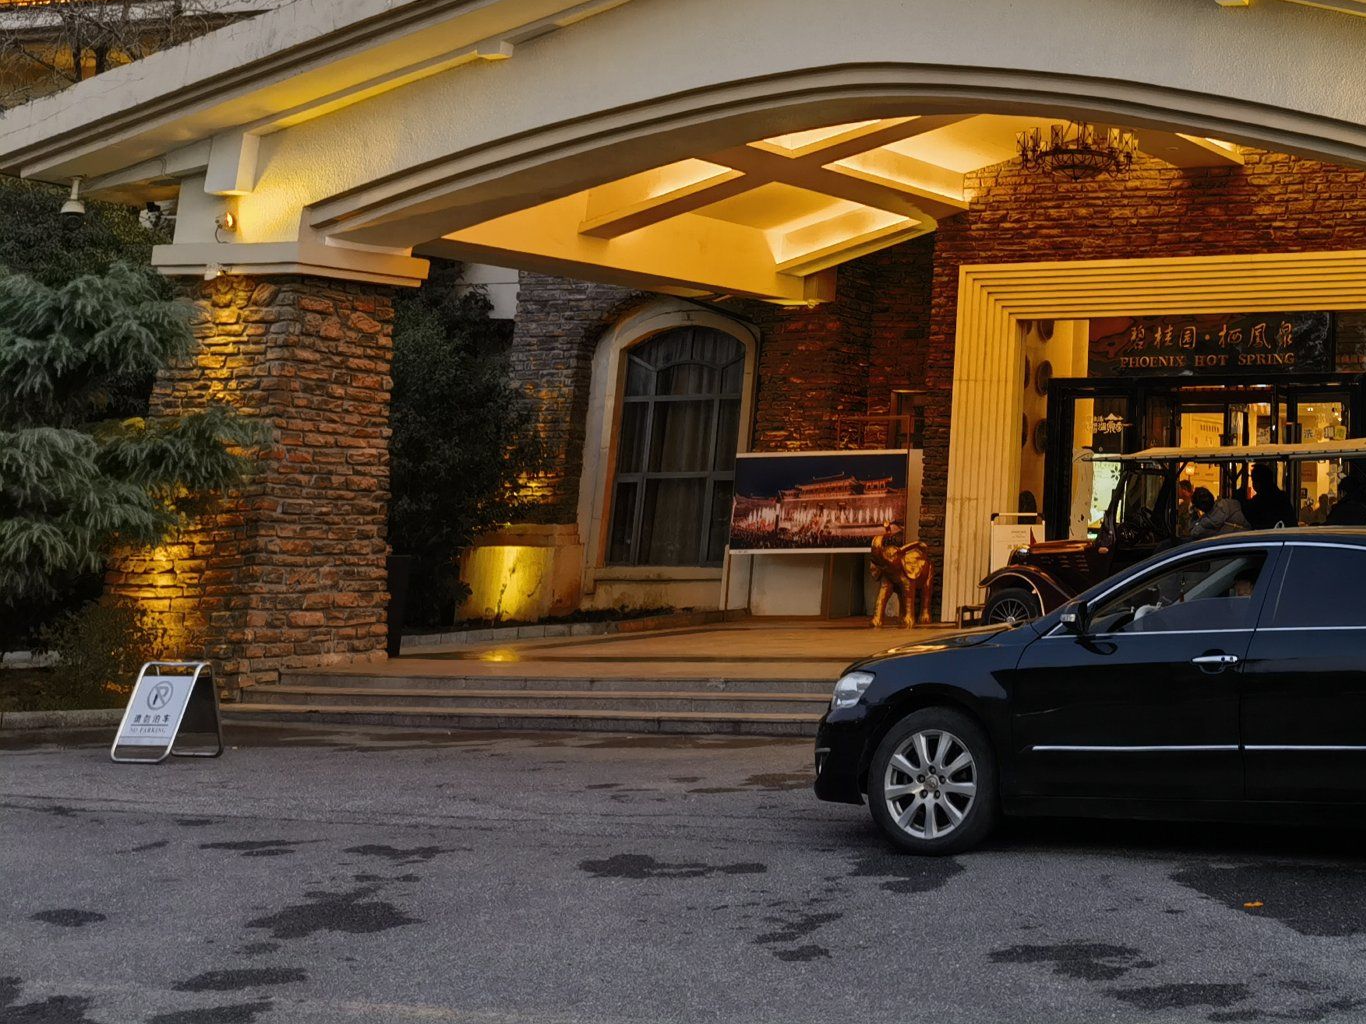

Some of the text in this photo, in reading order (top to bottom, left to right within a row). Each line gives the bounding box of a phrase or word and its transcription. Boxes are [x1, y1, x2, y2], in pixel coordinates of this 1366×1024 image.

[1120, 352, 1296, 368] PHOENIX HOT SPRING
